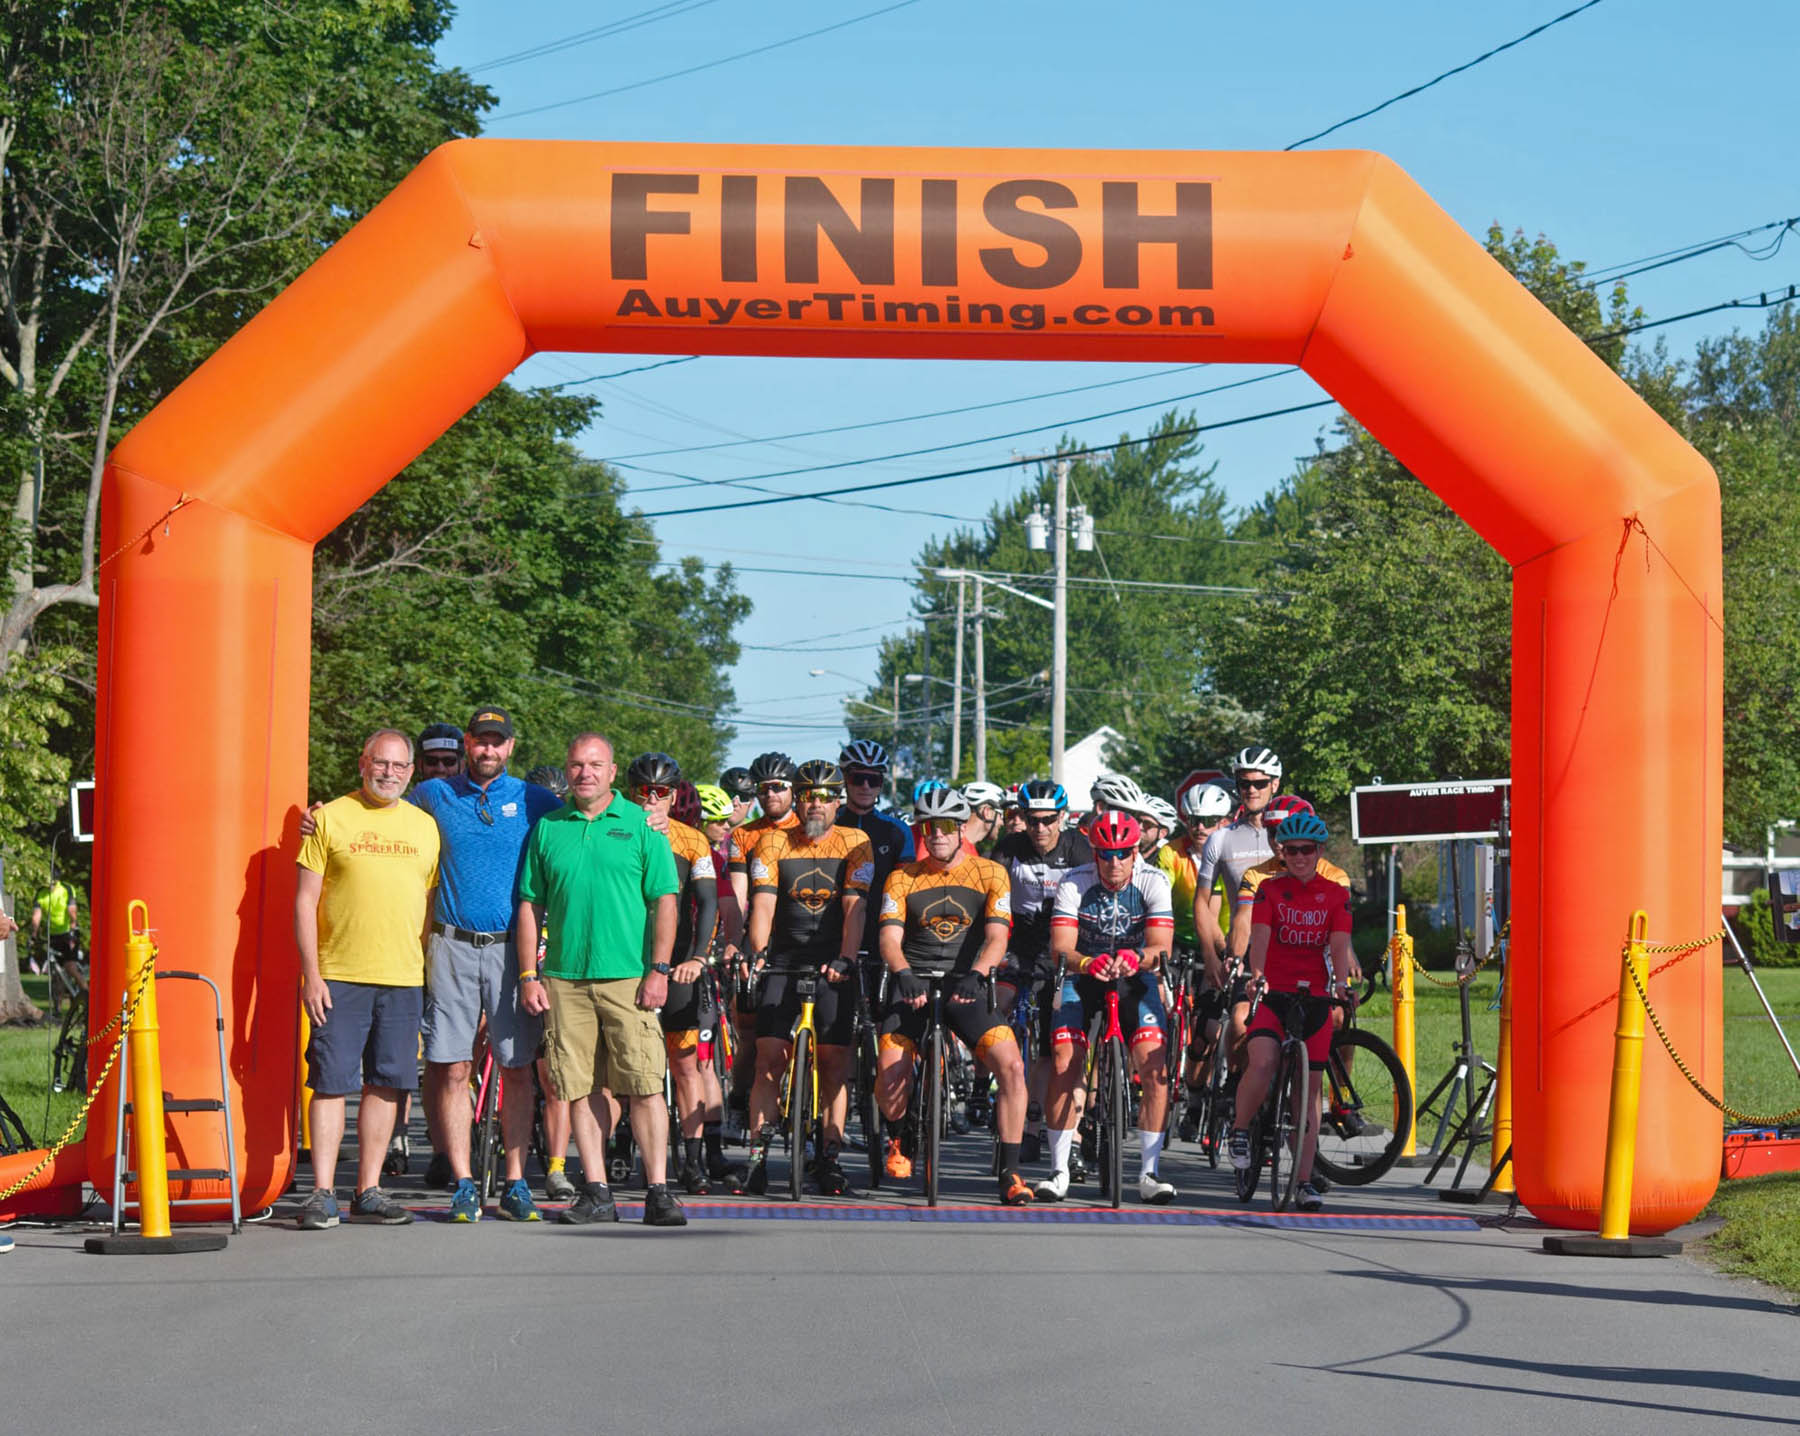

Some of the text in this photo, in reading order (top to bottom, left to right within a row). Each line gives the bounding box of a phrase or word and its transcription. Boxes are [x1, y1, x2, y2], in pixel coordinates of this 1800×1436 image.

[610, 173, 1213, 290] FINISH
[616, 288, 1215, 331] AuyerTiming.com
[1409, 788, 1439, 797] AUYER
[1440, 786, 1464, 795] RACE
